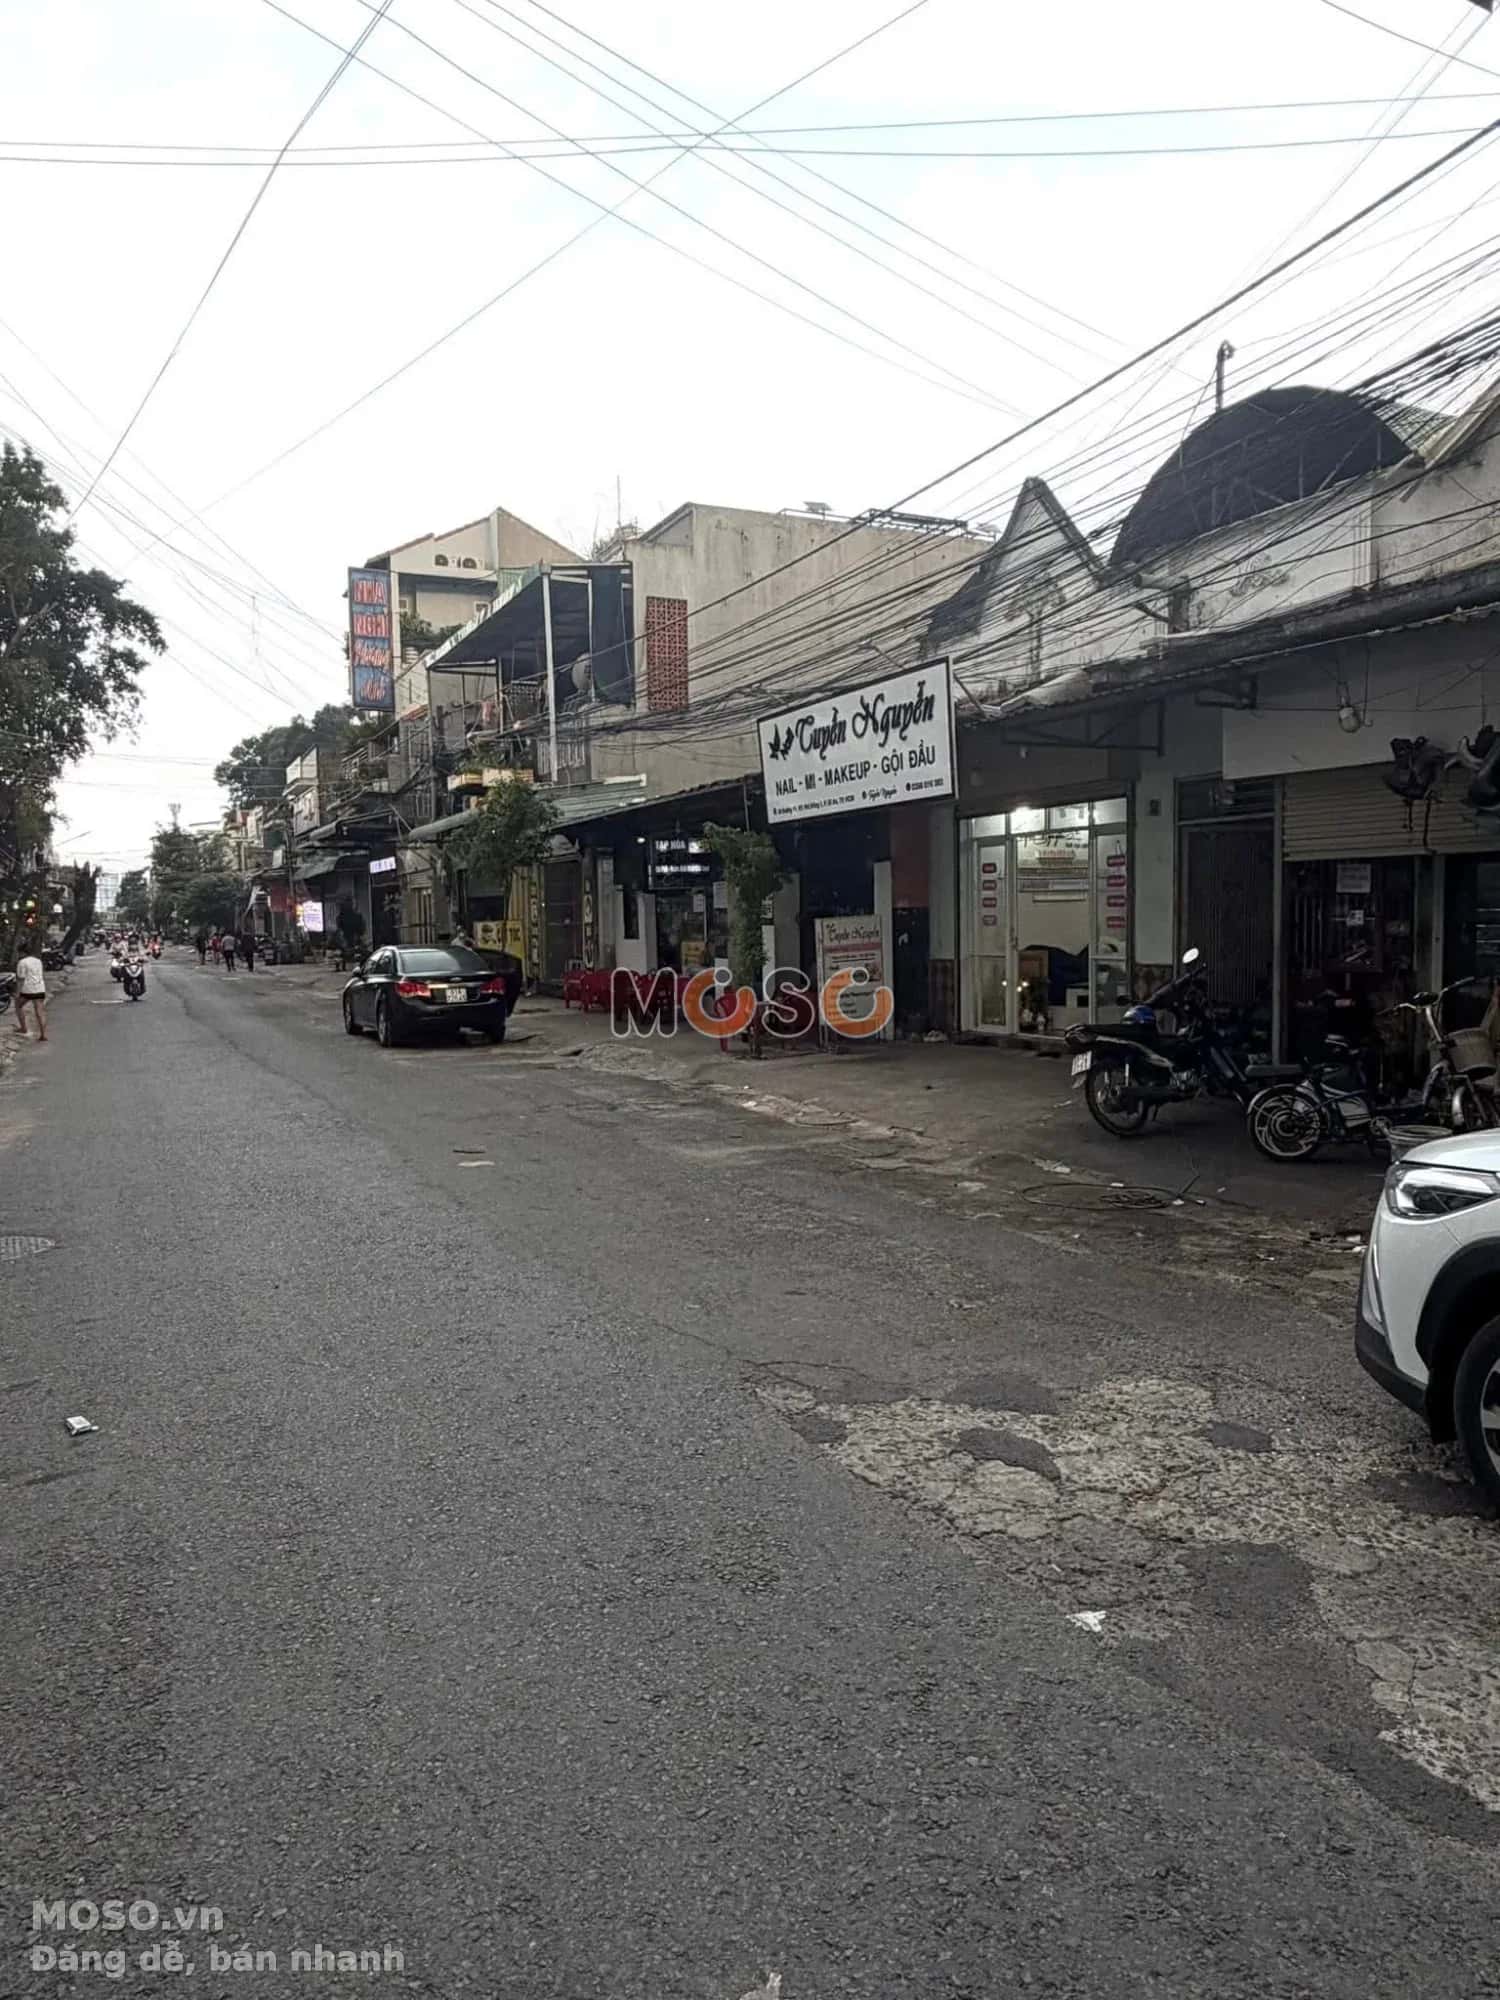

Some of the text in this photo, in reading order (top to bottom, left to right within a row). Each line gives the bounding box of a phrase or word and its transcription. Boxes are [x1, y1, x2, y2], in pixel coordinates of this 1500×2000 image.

[795, 679, 935, 761] Tuyền Nguyễn
[776, 777, 798, 797] NAIL
[824, 761, 871, 787] MAKEUP
[881, 748, 904, 777] GỘI
